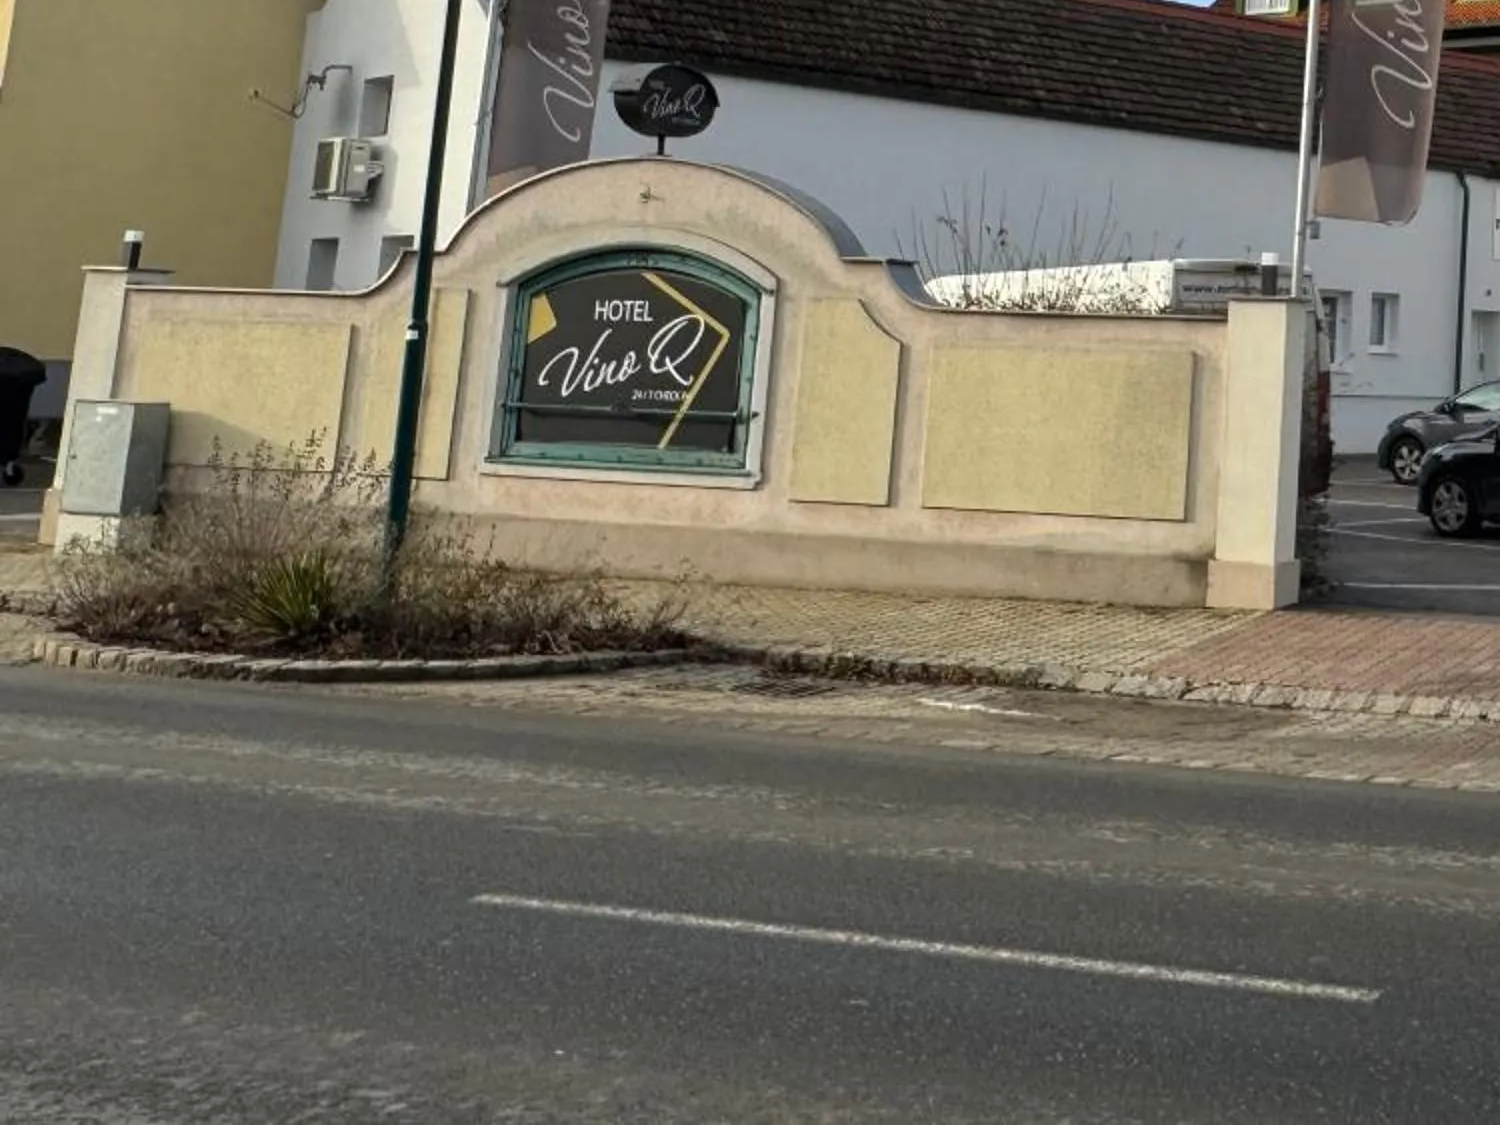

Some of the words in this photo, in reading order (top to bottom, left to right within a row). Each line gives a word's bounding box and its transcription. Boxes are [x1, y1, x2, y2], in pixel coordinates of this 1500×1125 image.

[526, 0, 596, 143] Vino
[594, 299, 653, 322] HOTEL
[538, 329, 641, 397] Vino
[648, 315, 705, 385] Q
